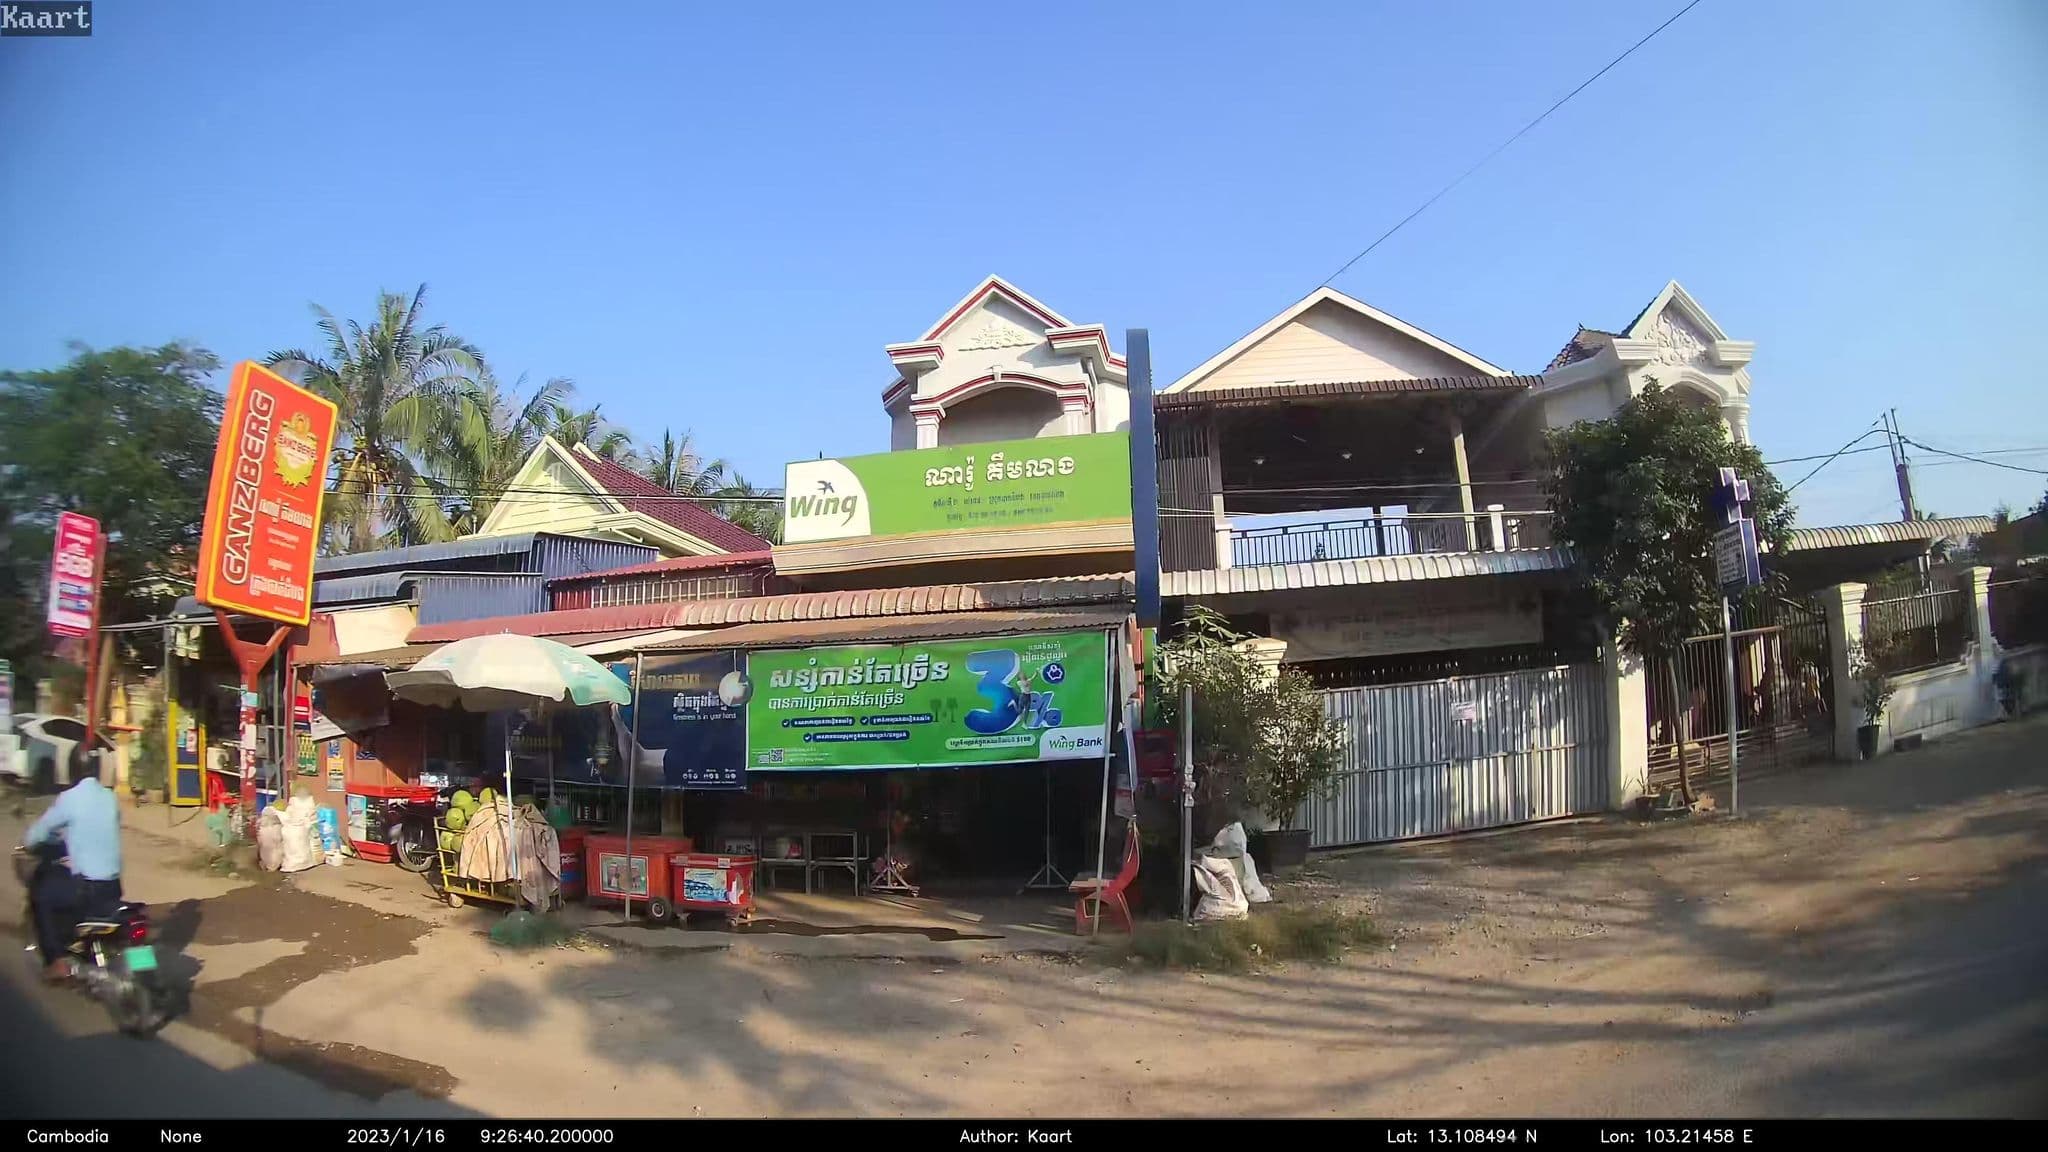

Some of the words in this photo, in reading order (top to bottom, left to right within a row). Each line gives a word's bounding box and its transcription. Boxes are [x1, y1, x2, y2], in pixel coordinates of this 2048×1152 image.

[221, 389, 277, 585] GANZBERG
[790, 494, 858, 527] Wing
[1049, 738, 1075, 751] Wing
[1076, 737, 1103, 748] Bank
